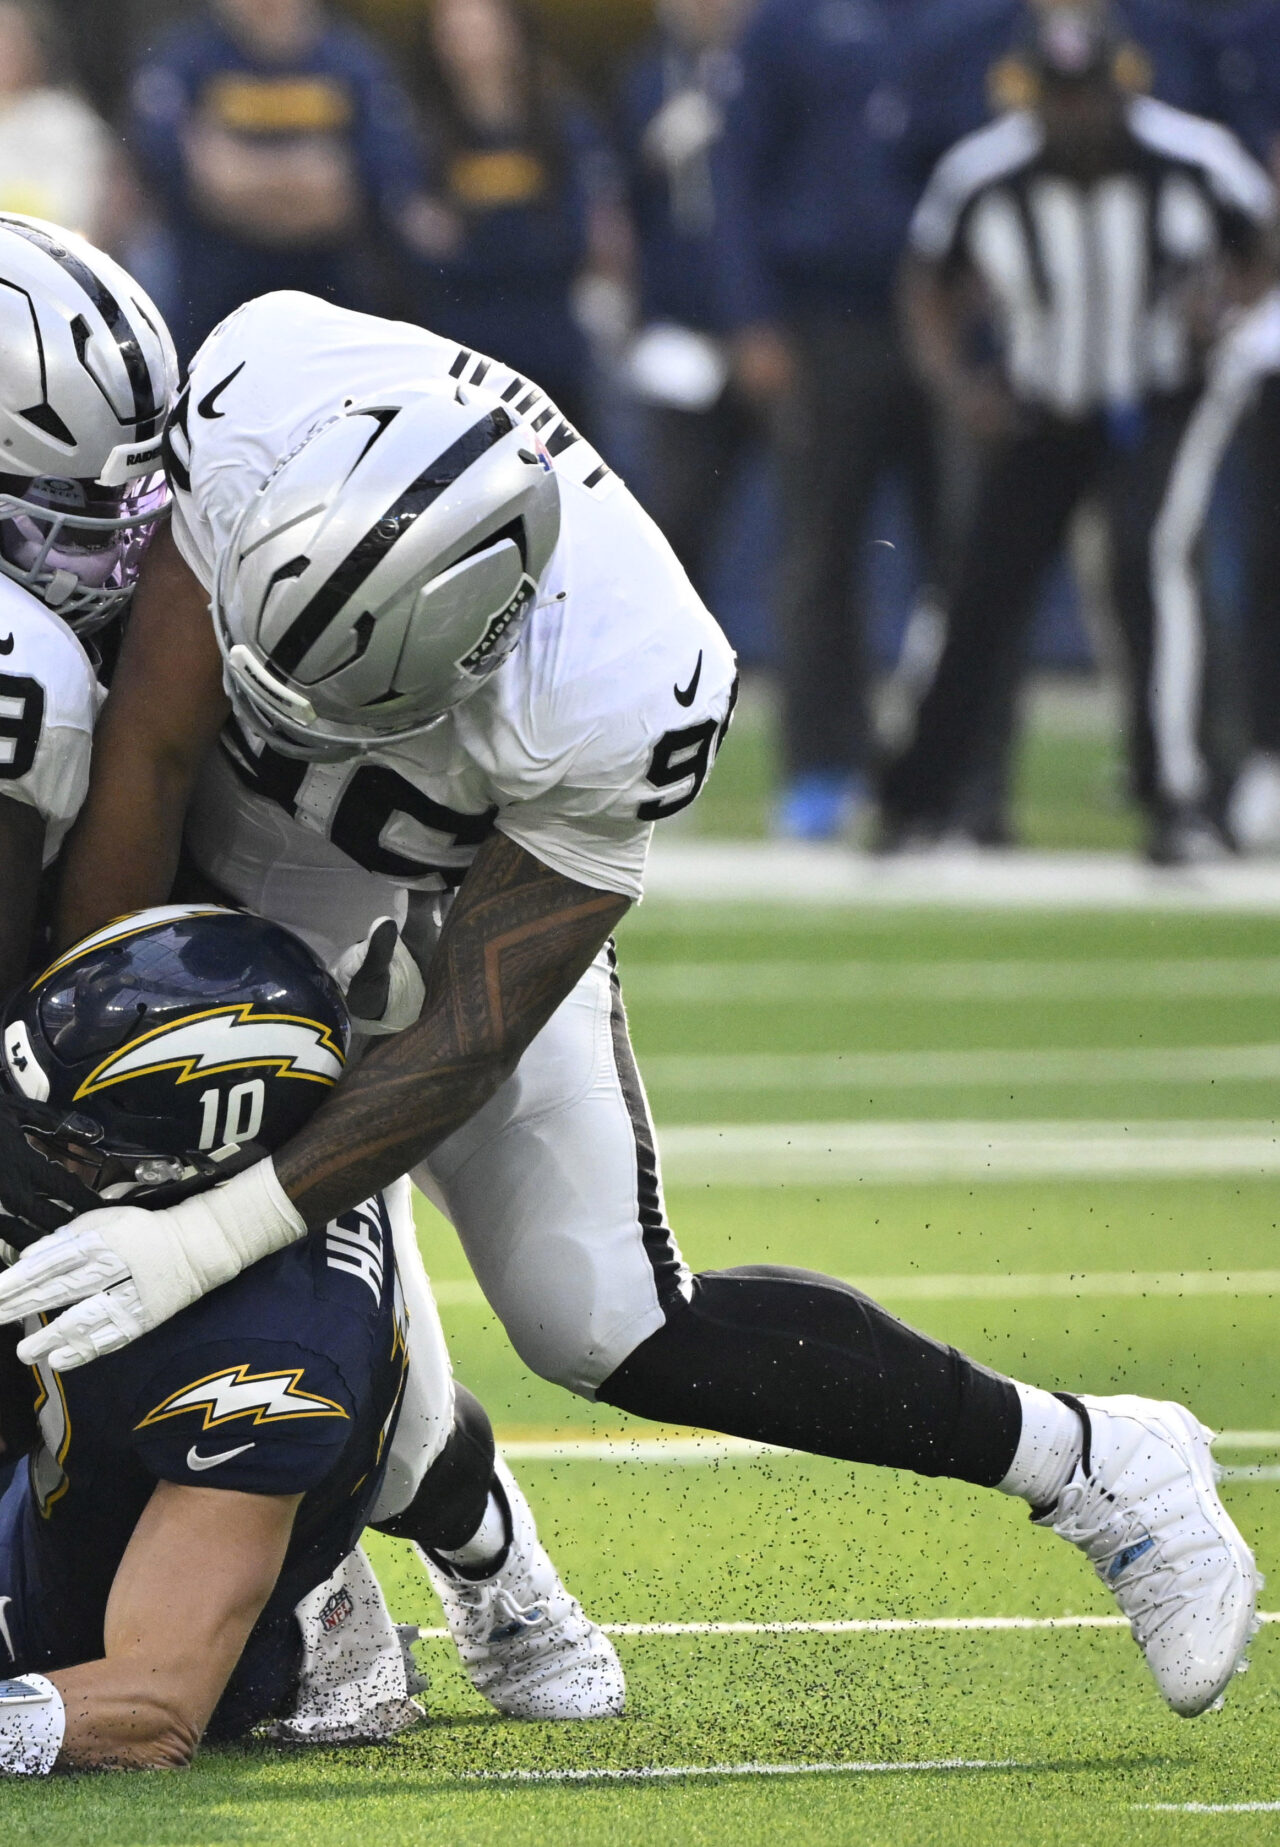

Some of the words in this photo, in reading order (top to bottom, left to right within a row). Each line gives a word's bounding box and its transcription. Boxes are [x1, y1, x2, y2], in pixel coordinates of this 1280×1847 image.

[126, 447, 164, 467] RAIDE
[469, 590, 526, 661] RAIDERS
[637, 676, 740, 822] 9
[197, 1078, 266, 1150] 10
